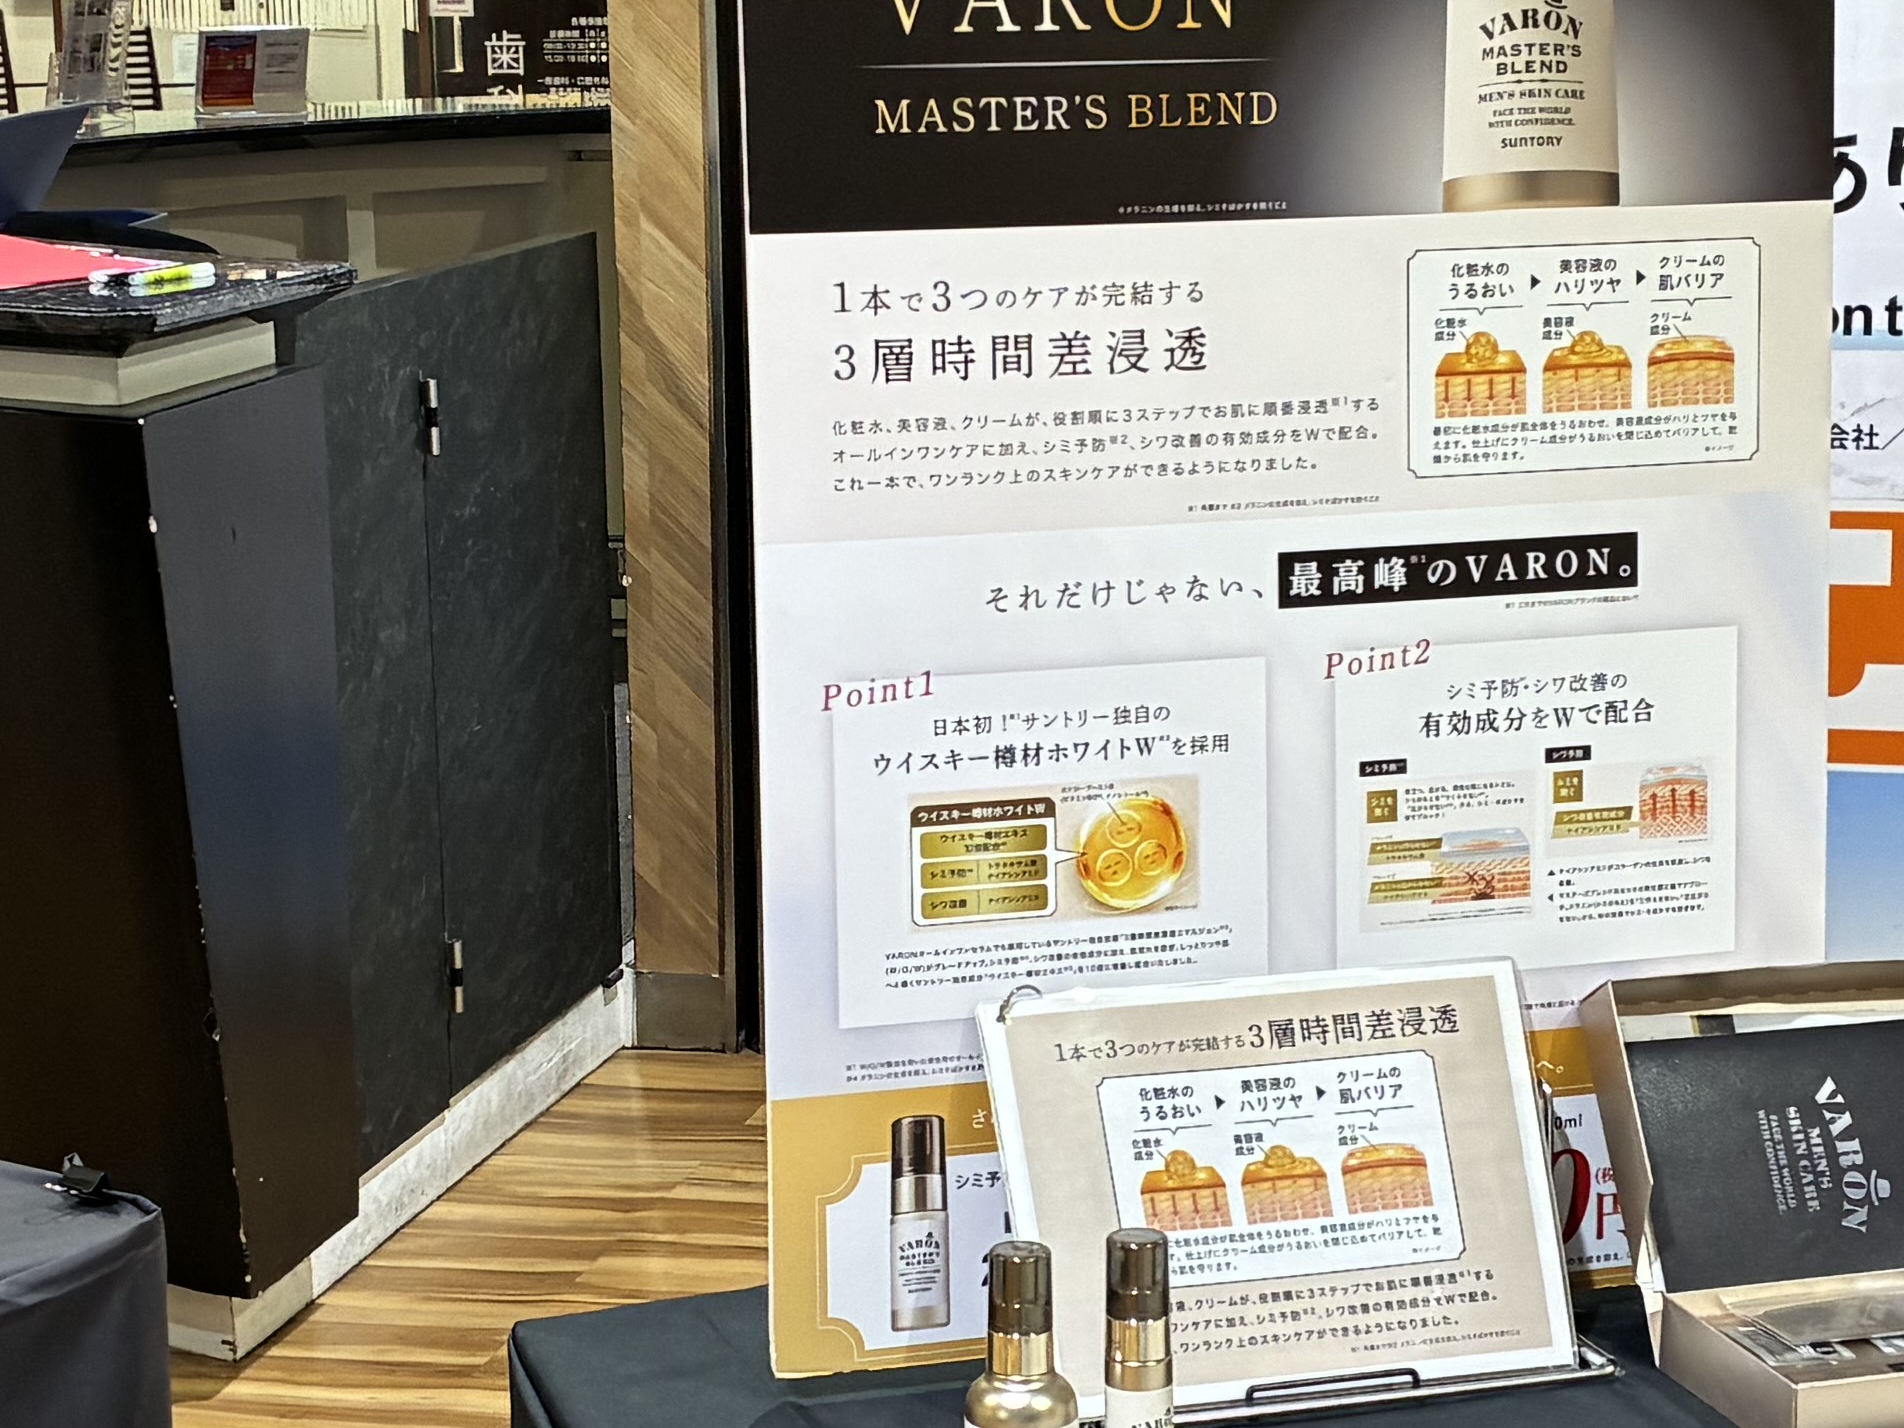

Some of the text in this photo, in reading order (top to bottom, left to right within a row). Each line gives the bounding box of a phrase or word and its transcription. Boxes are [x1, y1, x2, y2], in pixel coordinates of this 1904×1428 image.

[1479, 8, 1583, 41] VARON
[1482, 43, 1582, 61] MASTER'S
[1496, 60, 1568, 76] BLEND
[874, 90, 1279, 137] MASTER'S BLEND
[1501, 136, 1563, 148] SUNTORY
[1658, 253, 1725, 270] クリームの
[1447, 281, 1515, 301] うるおい
[1554, 276, 1622, 295] ハリツヤ
[1657, 271, 1725, 291] 肌バリア
[832, 280, 1205, 314] 1本で3つのケアが完結する
[832, 326, 1209, 384] 3層時間差浸透
[986, 575, 1264, 613] それだけじゃない、
[1419, 698, 1656, 739] 有効成分をWで配合
[1336, 1065, 1402, 1085] クリームの
[1814, 1075, 1869, 1234] VARON
